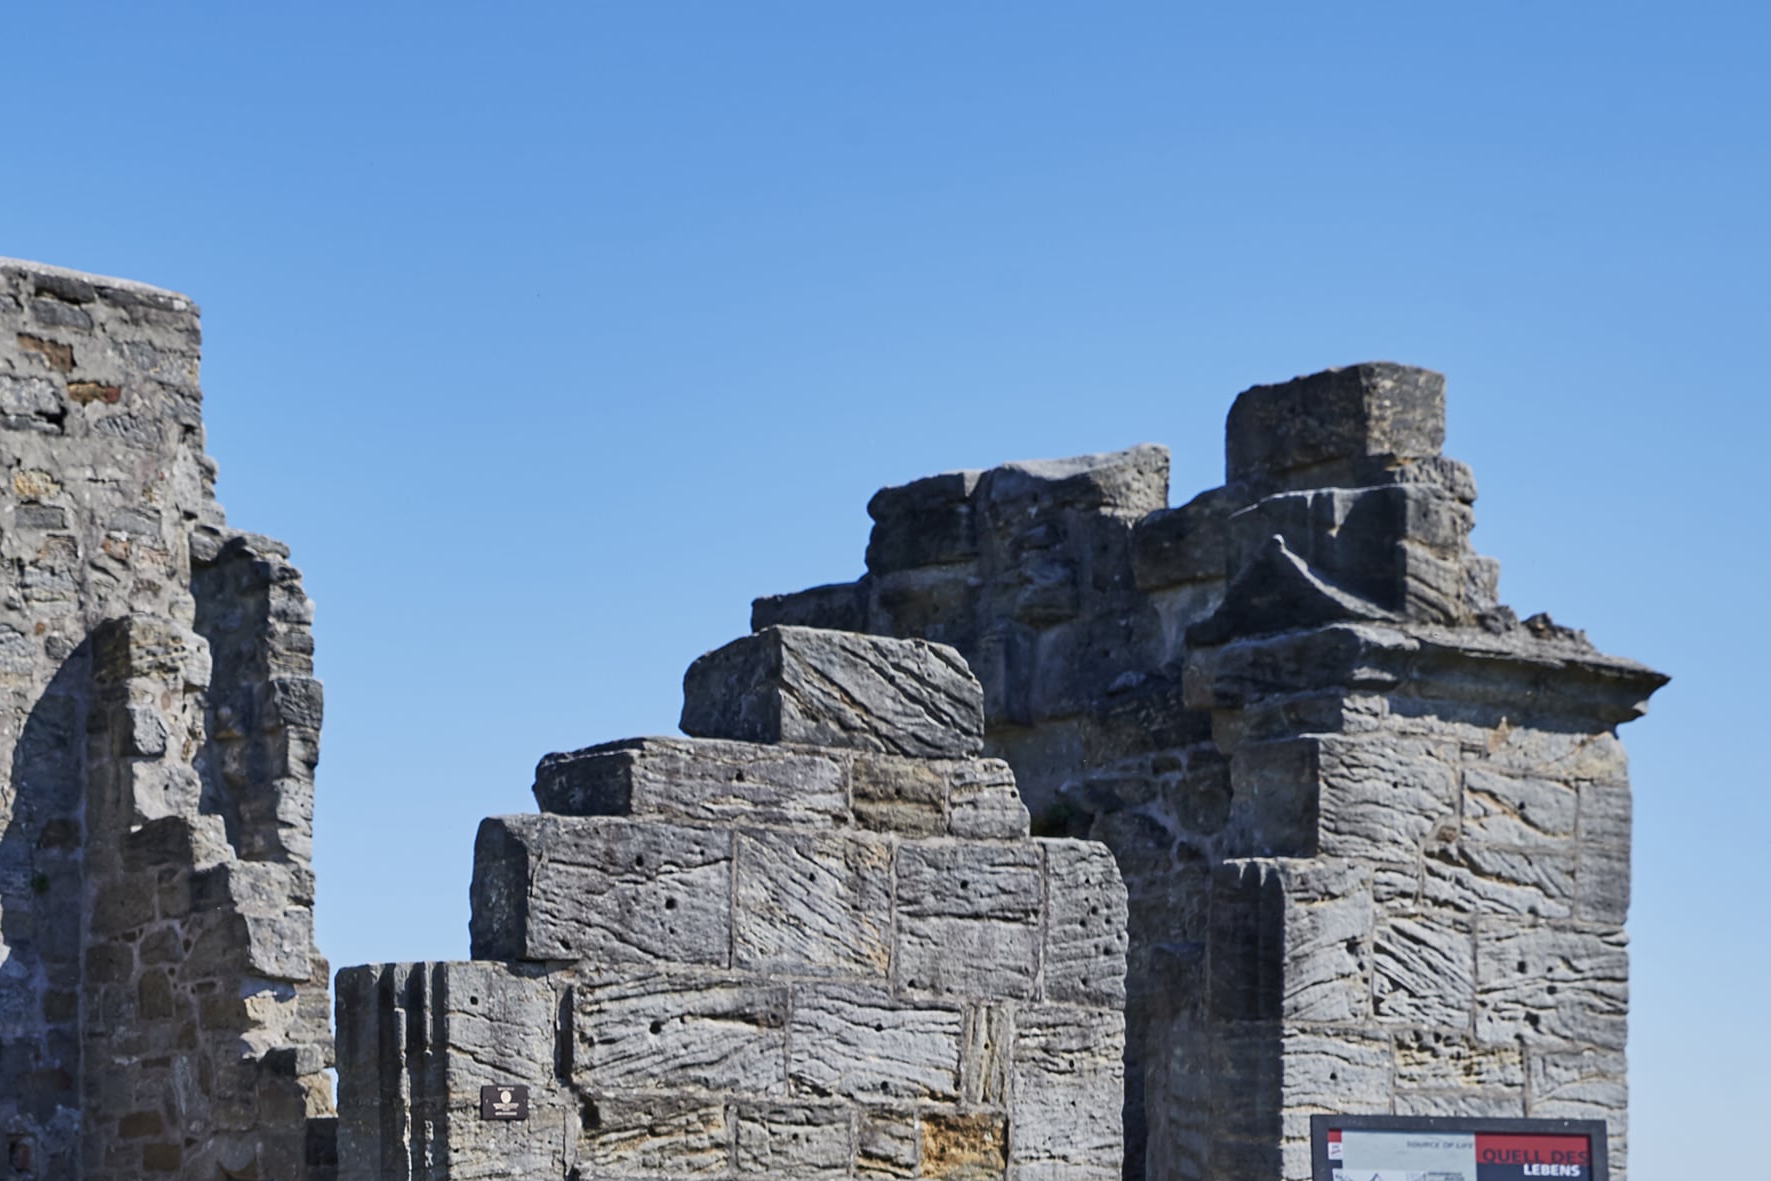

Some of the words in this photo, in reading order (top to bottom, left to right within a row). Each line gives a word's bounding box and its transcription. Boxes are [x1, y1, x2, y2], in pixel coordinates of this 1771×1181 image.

[1482, 1148, 1545, 1164] QUELL
[1551, 1150, 1589, 1165] DES
[1523, 1163, 1581, 1177] LEBENS
